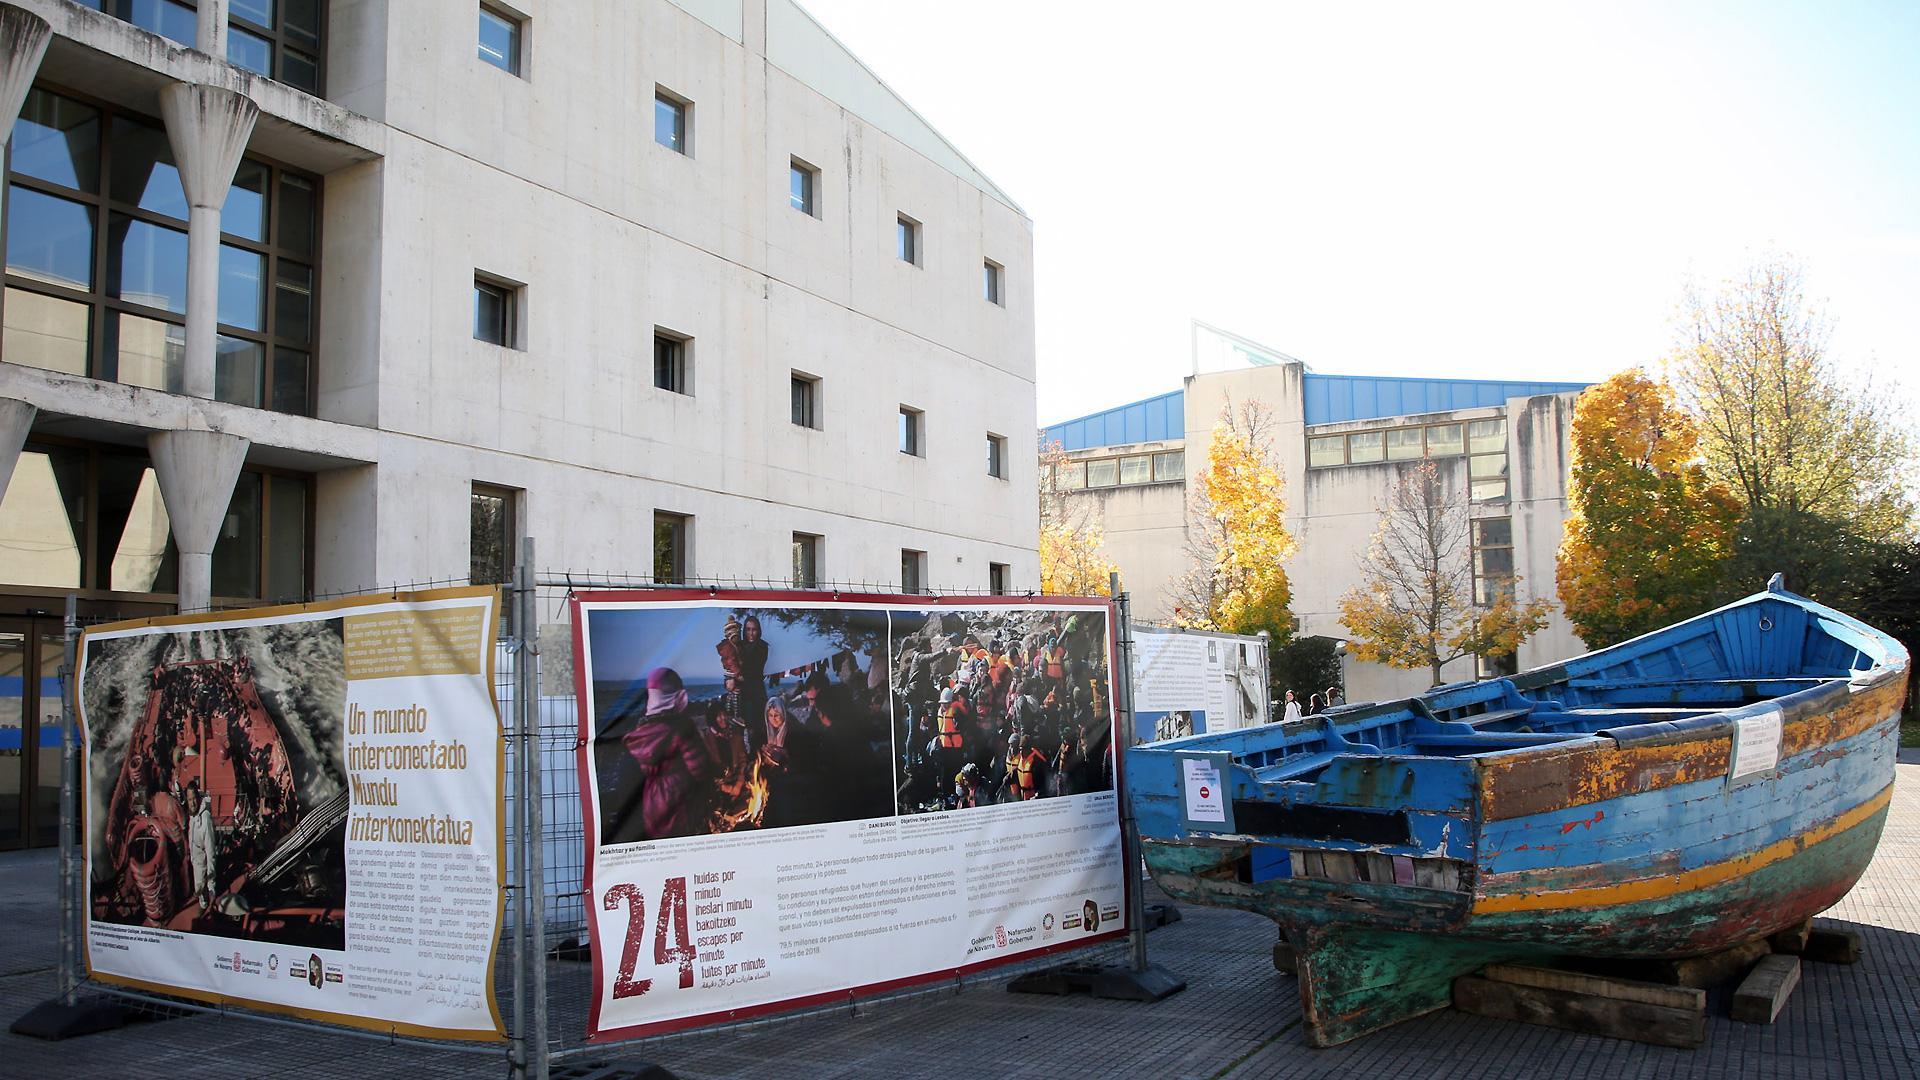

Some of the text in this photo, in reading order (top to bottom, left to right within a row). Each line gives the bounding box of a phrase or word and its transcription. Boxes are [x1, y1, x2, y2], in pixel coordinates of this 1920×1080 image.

[348, 703, 427, 735] Un mundo
[348, 740, 467, 770] interconectado
[351, 774, 398, 806] Mundu
[350, 812, 472, 846] interkonektatua
[777, 863, 792, 872] Cada
[823, 858, 849, 868] personas
[850, 856, 865, 864] dejan
[866, 853, 878, 861] todo
[694, 870, 736, 884] huidas por
[695, 887, 721, 900] minuto
[790, 889, 818, 901] personas
[850, 884, 861, 892] que
[726, 898, 752, 912] minutu
[812, 907, 830, 915] deben
[696, 916, 736, 931] bakoitzeko
[793, 938, 819, 947] millones
[828, 932, 853, 944] personas
[899, 922, 916, 930] fuerza
[929, 915, 947, 925] mundo
[1008, 926, 1037, 936] Nafarroako
[604, 876, 696, 1000] 24
[697, 931, 744, 948] escapes per
[971, 935, 993, 945] Gobierno
[1009, 935, 1033, 944] Gobernua
[699, 949, 725, 962] minute
[974, 944, 995, 952] Navarra
[725, 963, 738, 977] par
[741, 958, 766, 972] minute
